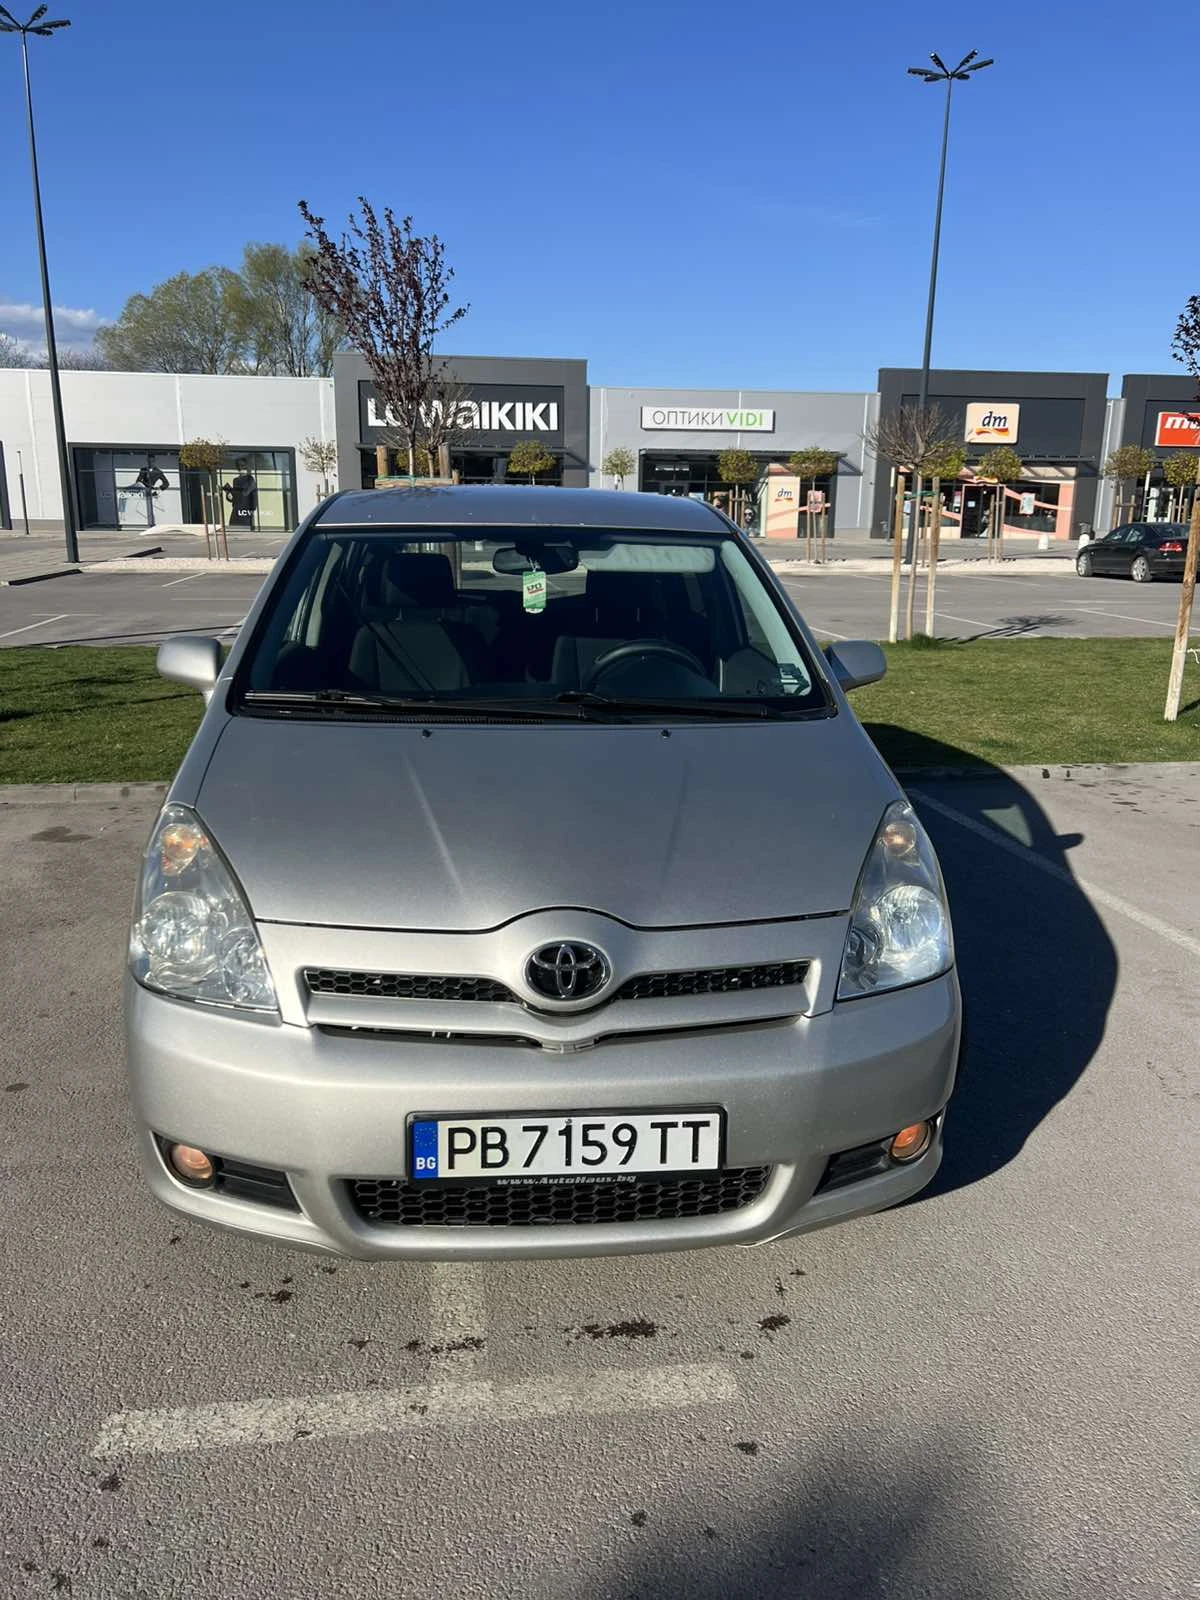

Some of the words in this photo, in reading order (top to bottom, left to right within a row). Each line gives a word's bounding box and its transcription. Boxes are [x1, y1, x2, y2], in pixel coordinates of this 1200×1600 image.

[652, 410, 723, 426] ОПТИКИ
[726, 412, 763, 426] VIDI
[982, 411, 1008, 427] dm
[448, 1127, 510, 1170] PB
[522, 1123, 638, 1168] 7159
[650, 1120, 711, 1164] TT
[416, 1157, 437, 1170] BG
